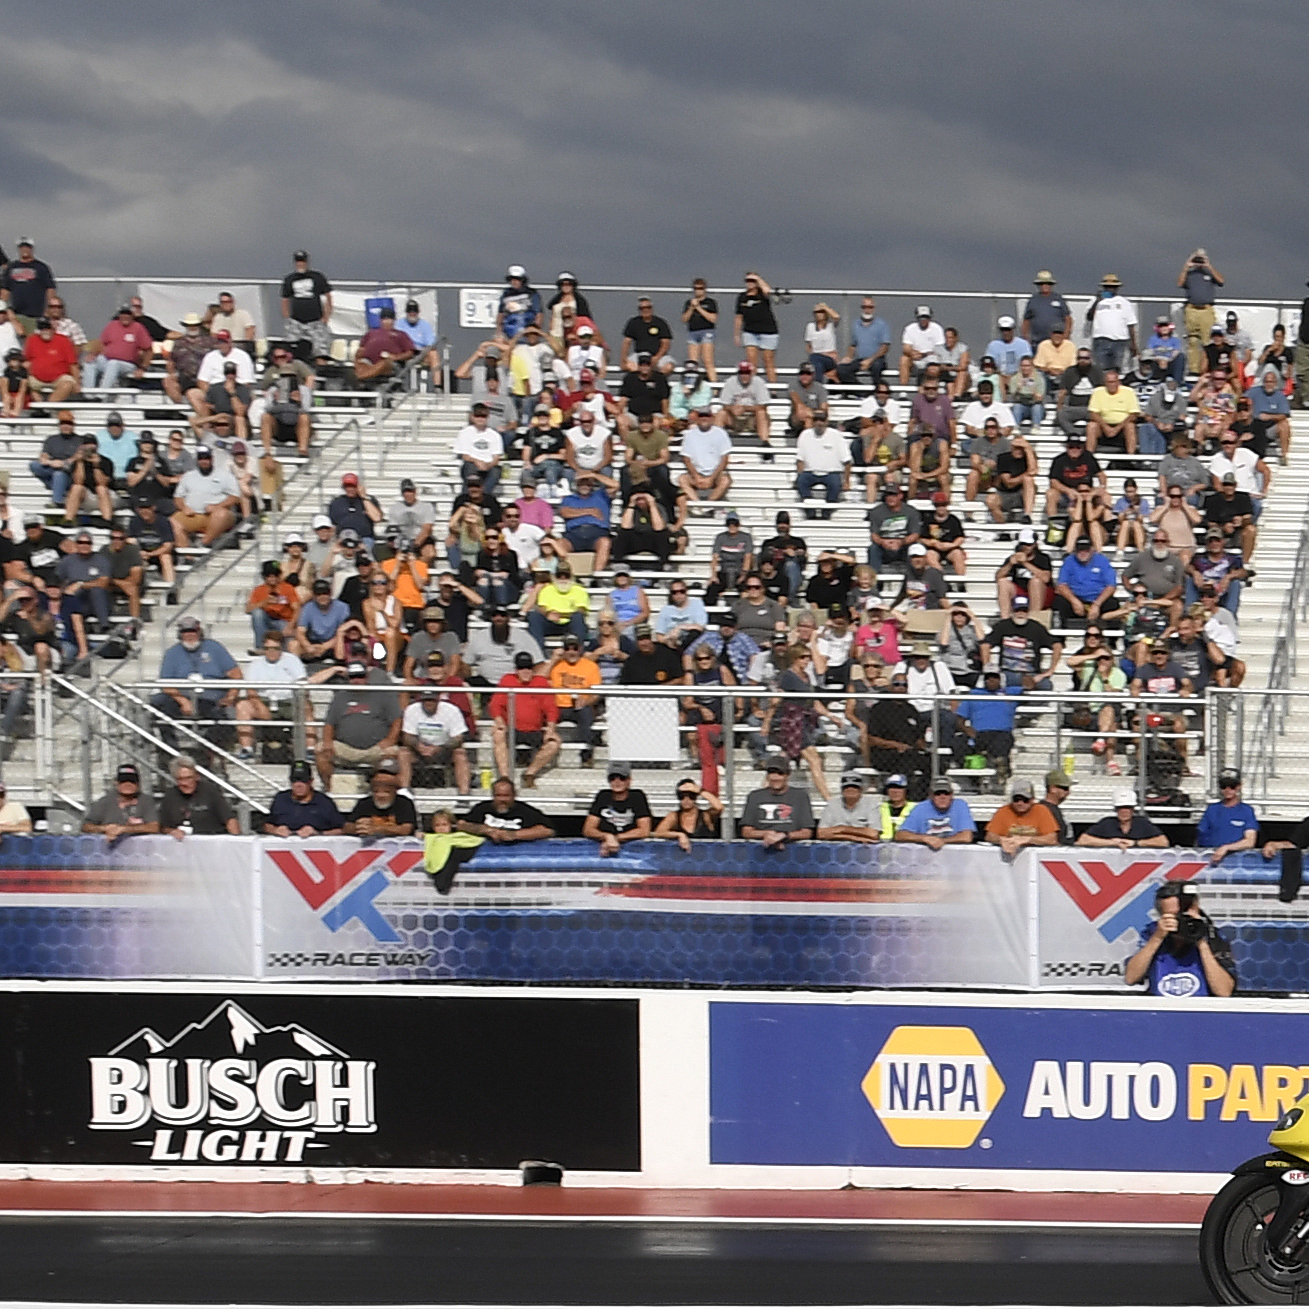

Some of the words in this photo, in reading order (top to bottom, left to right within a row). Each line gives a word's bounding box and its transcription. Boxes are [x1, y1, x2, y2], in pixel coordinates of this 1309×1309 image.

[311, 951, 431, 968] RACEWAY
[89, 1057, 377, 1132] BUSCH
[888, 1060, 982, 1113] NAPA
[1023, 1061, 1177, 1121] AUTO
[150, 1130, 316, 1162] LIGHT
